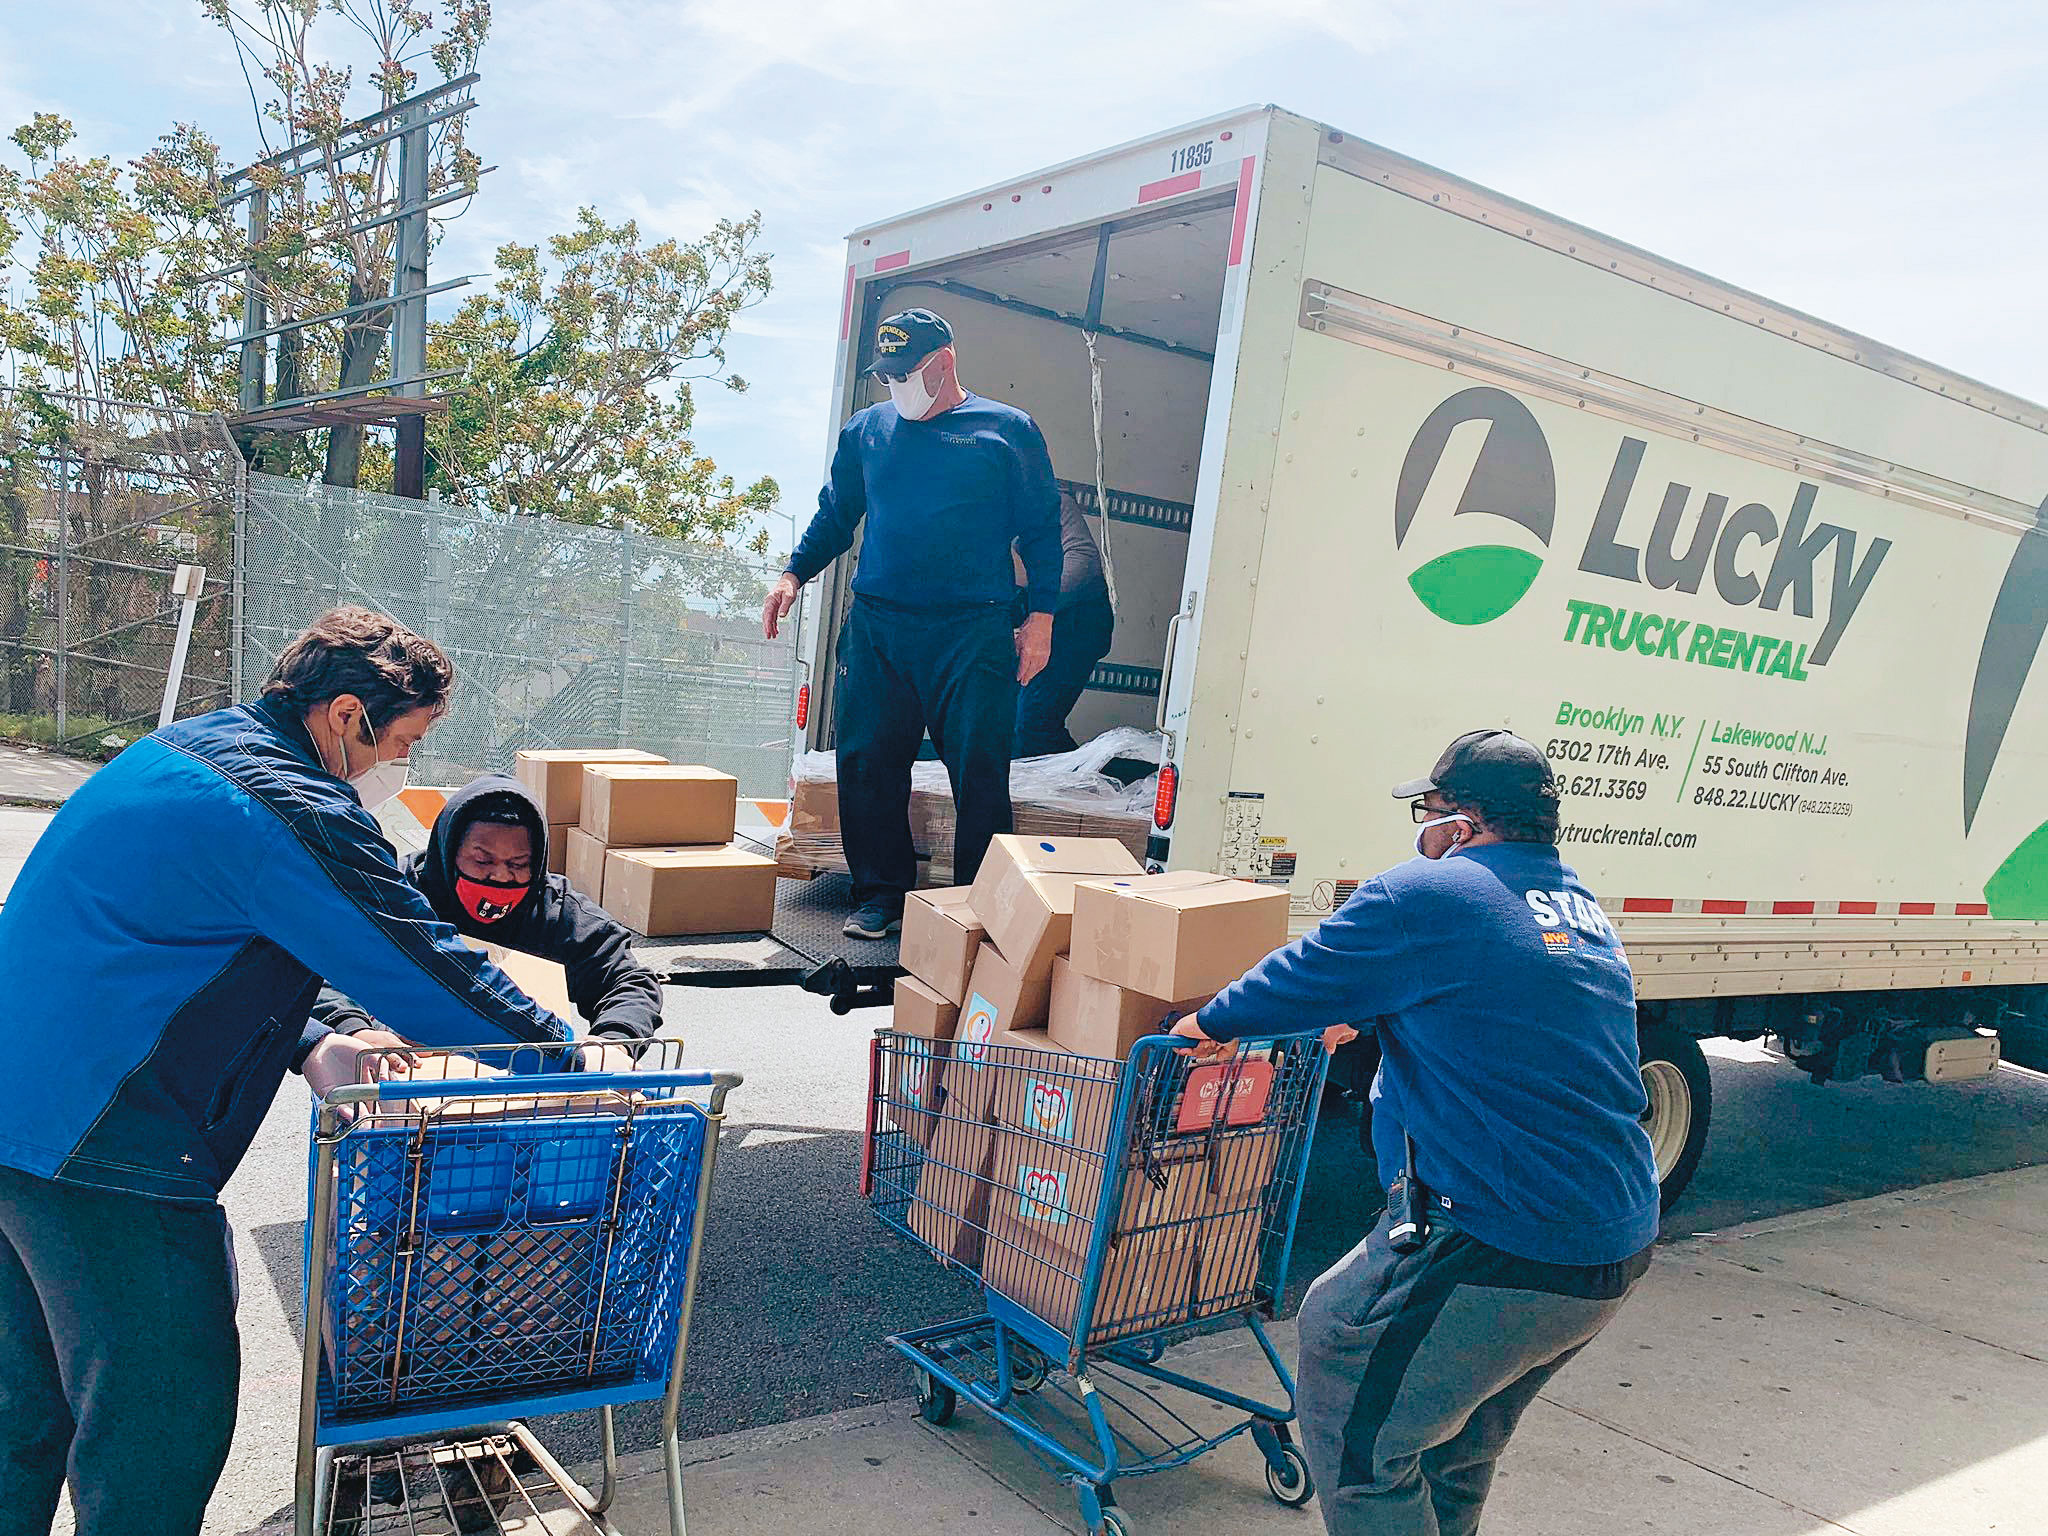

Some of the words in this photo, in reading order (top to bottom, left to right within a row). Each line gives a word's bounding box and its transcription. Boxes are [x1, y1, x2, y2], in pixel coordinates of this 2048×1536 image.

[1171, 140, 1214, 173] 11835
[1578, 436, 1893, 667] Lucky
[1563, 599, 1691, 661] TRUCK
[1685, 623, 1809, 682] RENTAL
[1555, 701, 1645, 737] Brooklyn
[1650, 713, 1686, 739] N.Y.
[1545, 738, 1593, 763] 6302
[1596, 743, 1632, 767] 17th
[1634, 748, 1670, 770] Ave.
[1711, 720, 1799, 752] Lakewood
[1798, 732, 1828, 756] N.J.
[1702, 755, 1724, 775] 55
[1725, 757, 1768, 779] South
[1772, 762, 1819, 784] Clifton
[1820, 767, 1849, 787] Ave.
[1555, 774, 1647, 801] 8.621.3369
[1693, 786, 1800, 812] 848.22.LUCKY
[1554, 823, 1698, 849] ytruckrental.com
